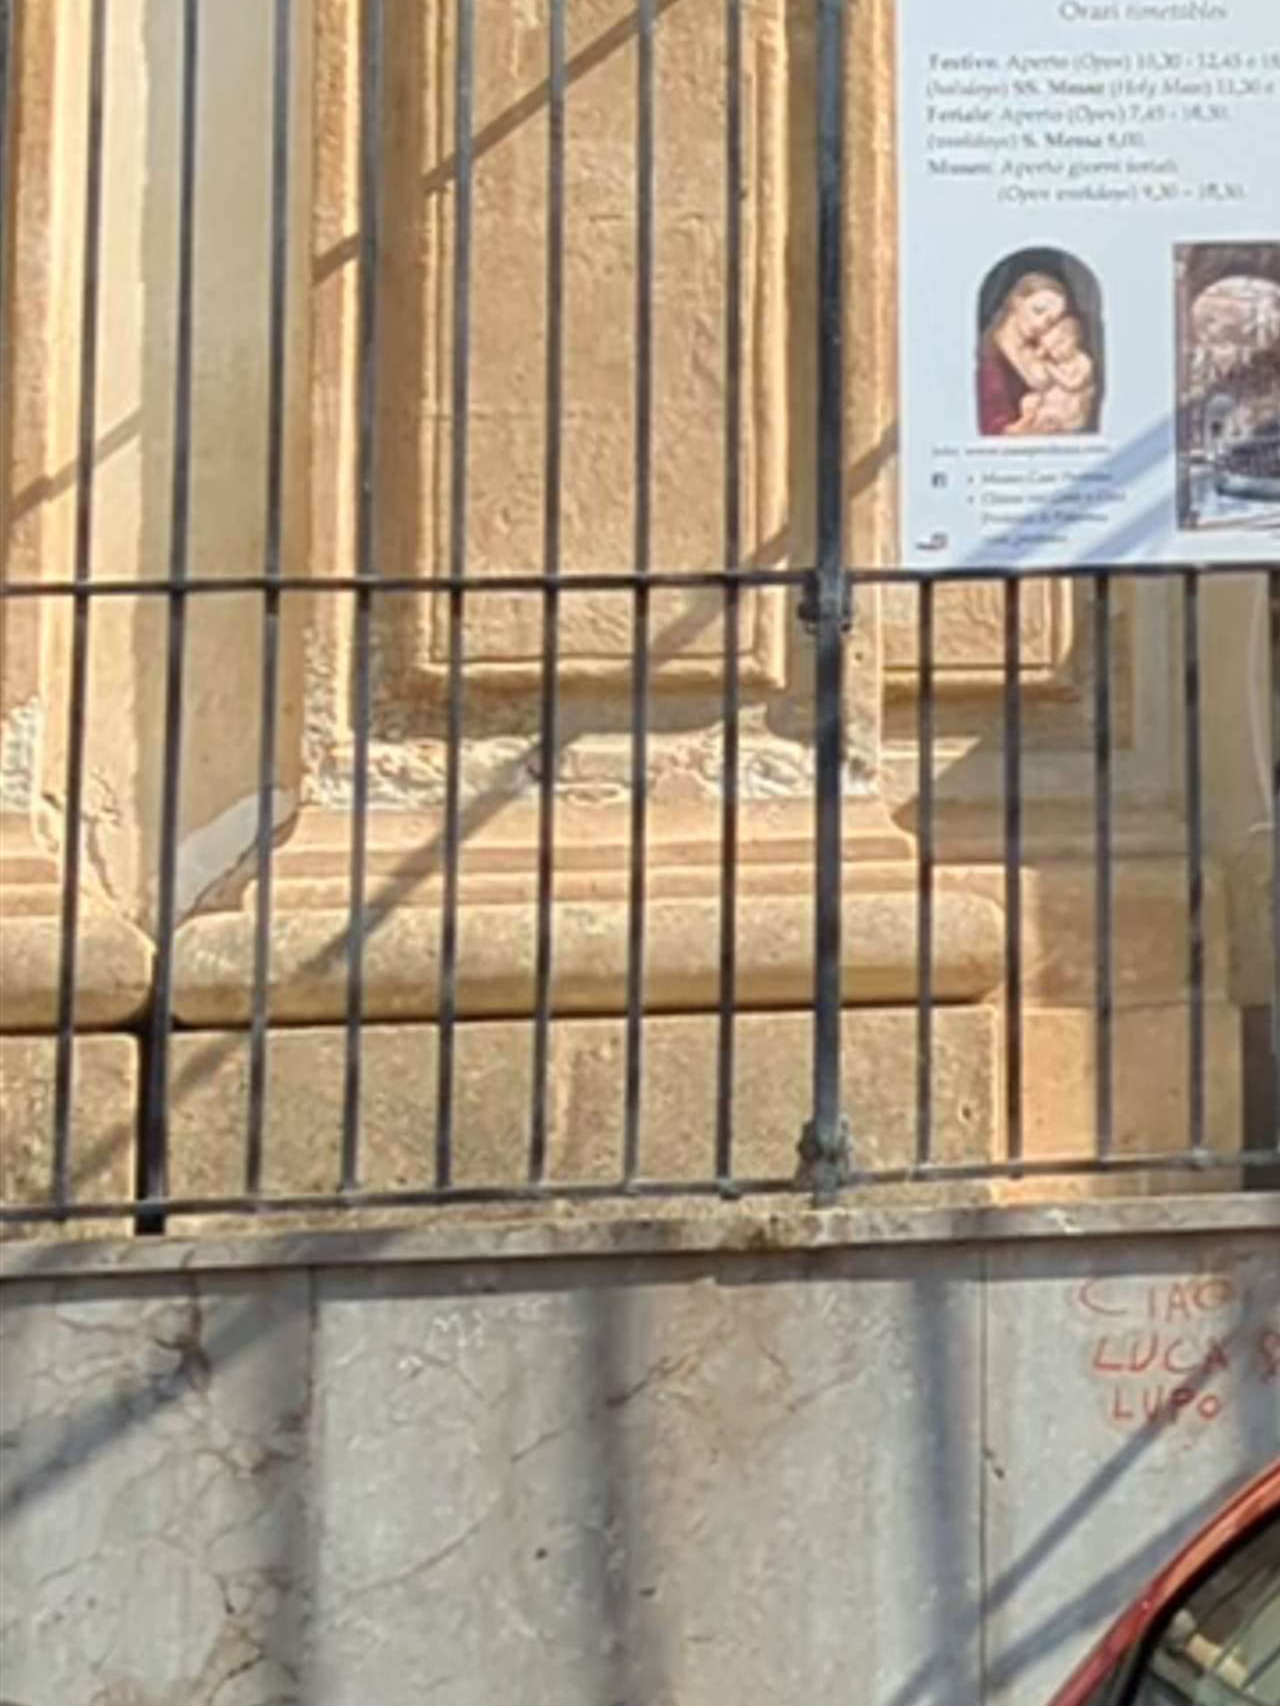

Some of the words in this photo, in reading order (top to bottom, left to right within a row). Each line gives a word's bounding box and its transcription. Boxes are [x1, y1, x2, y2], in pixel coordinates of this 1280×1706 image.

[1058, 0, 1120, 21] Orari
[1078, 1276, 1237, 1322] CIAO
[1092, 1333, 1230, 1374] LUCA
[1111, 1386, 1223, 1424] LUPO
